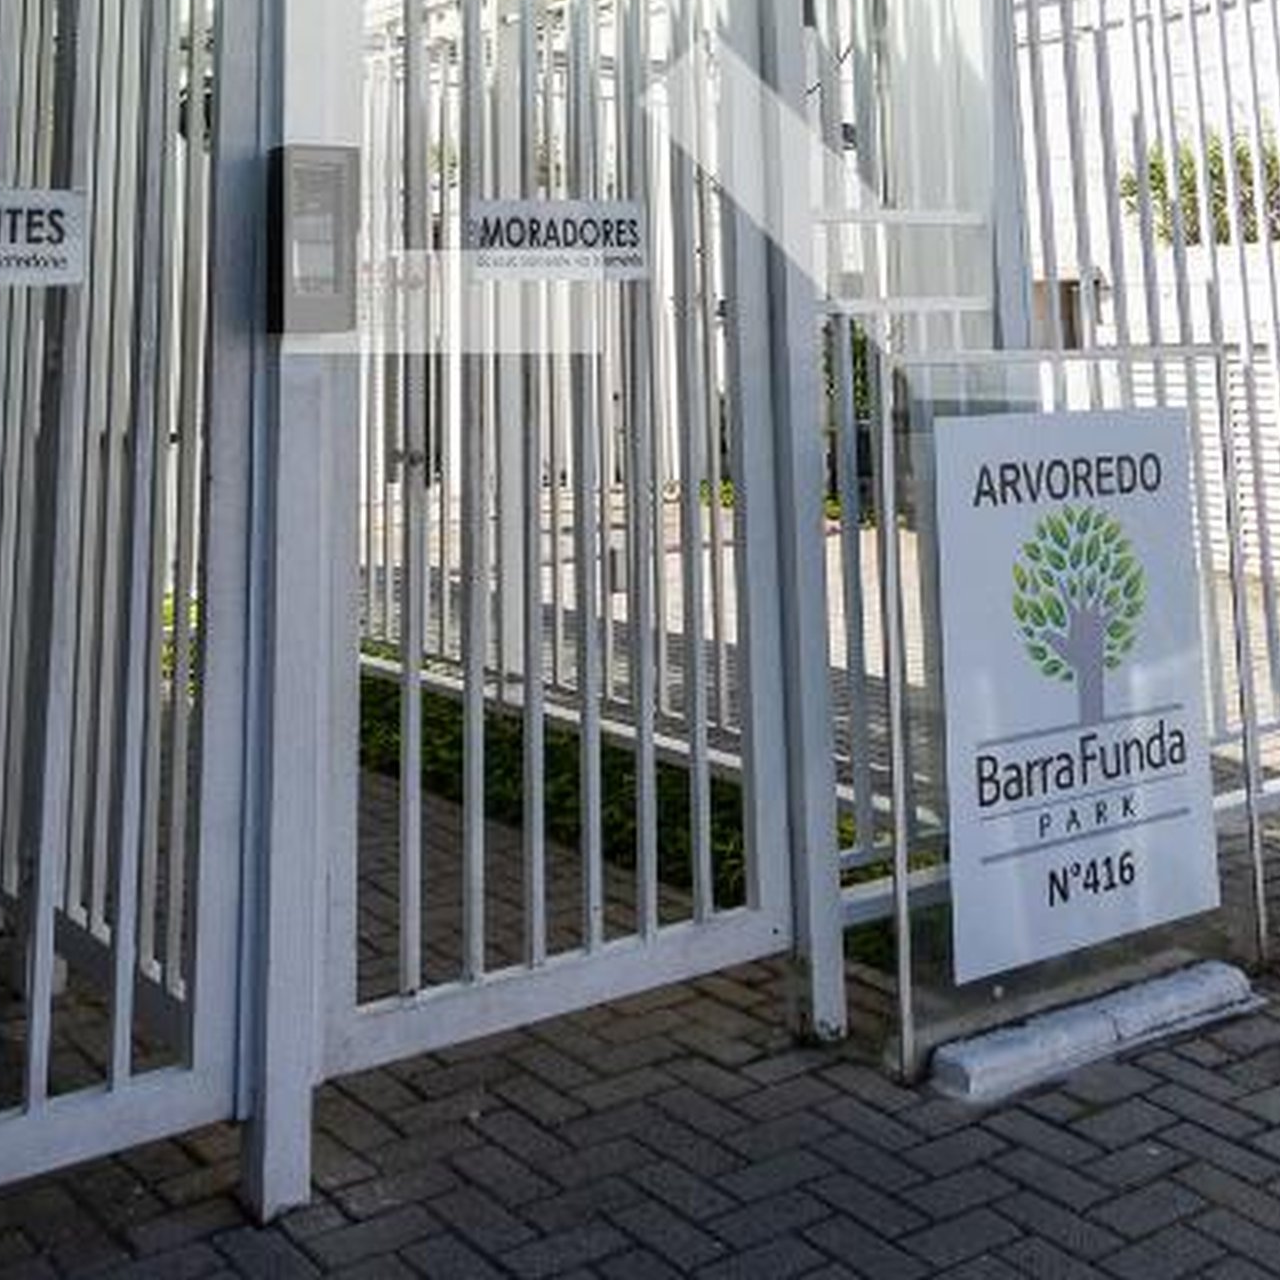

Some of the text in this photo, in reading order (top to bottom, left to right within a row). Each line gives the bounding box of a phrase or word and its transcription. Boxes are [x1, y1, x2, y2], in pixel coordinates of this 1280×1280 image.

[478, 215, 642, 248] MORADORES
[972, 452, 1162, 508] ARVOREDO
[976, 719, 1188, 808] Barra Funda
[1038, 792, 1137, 839] PARK
